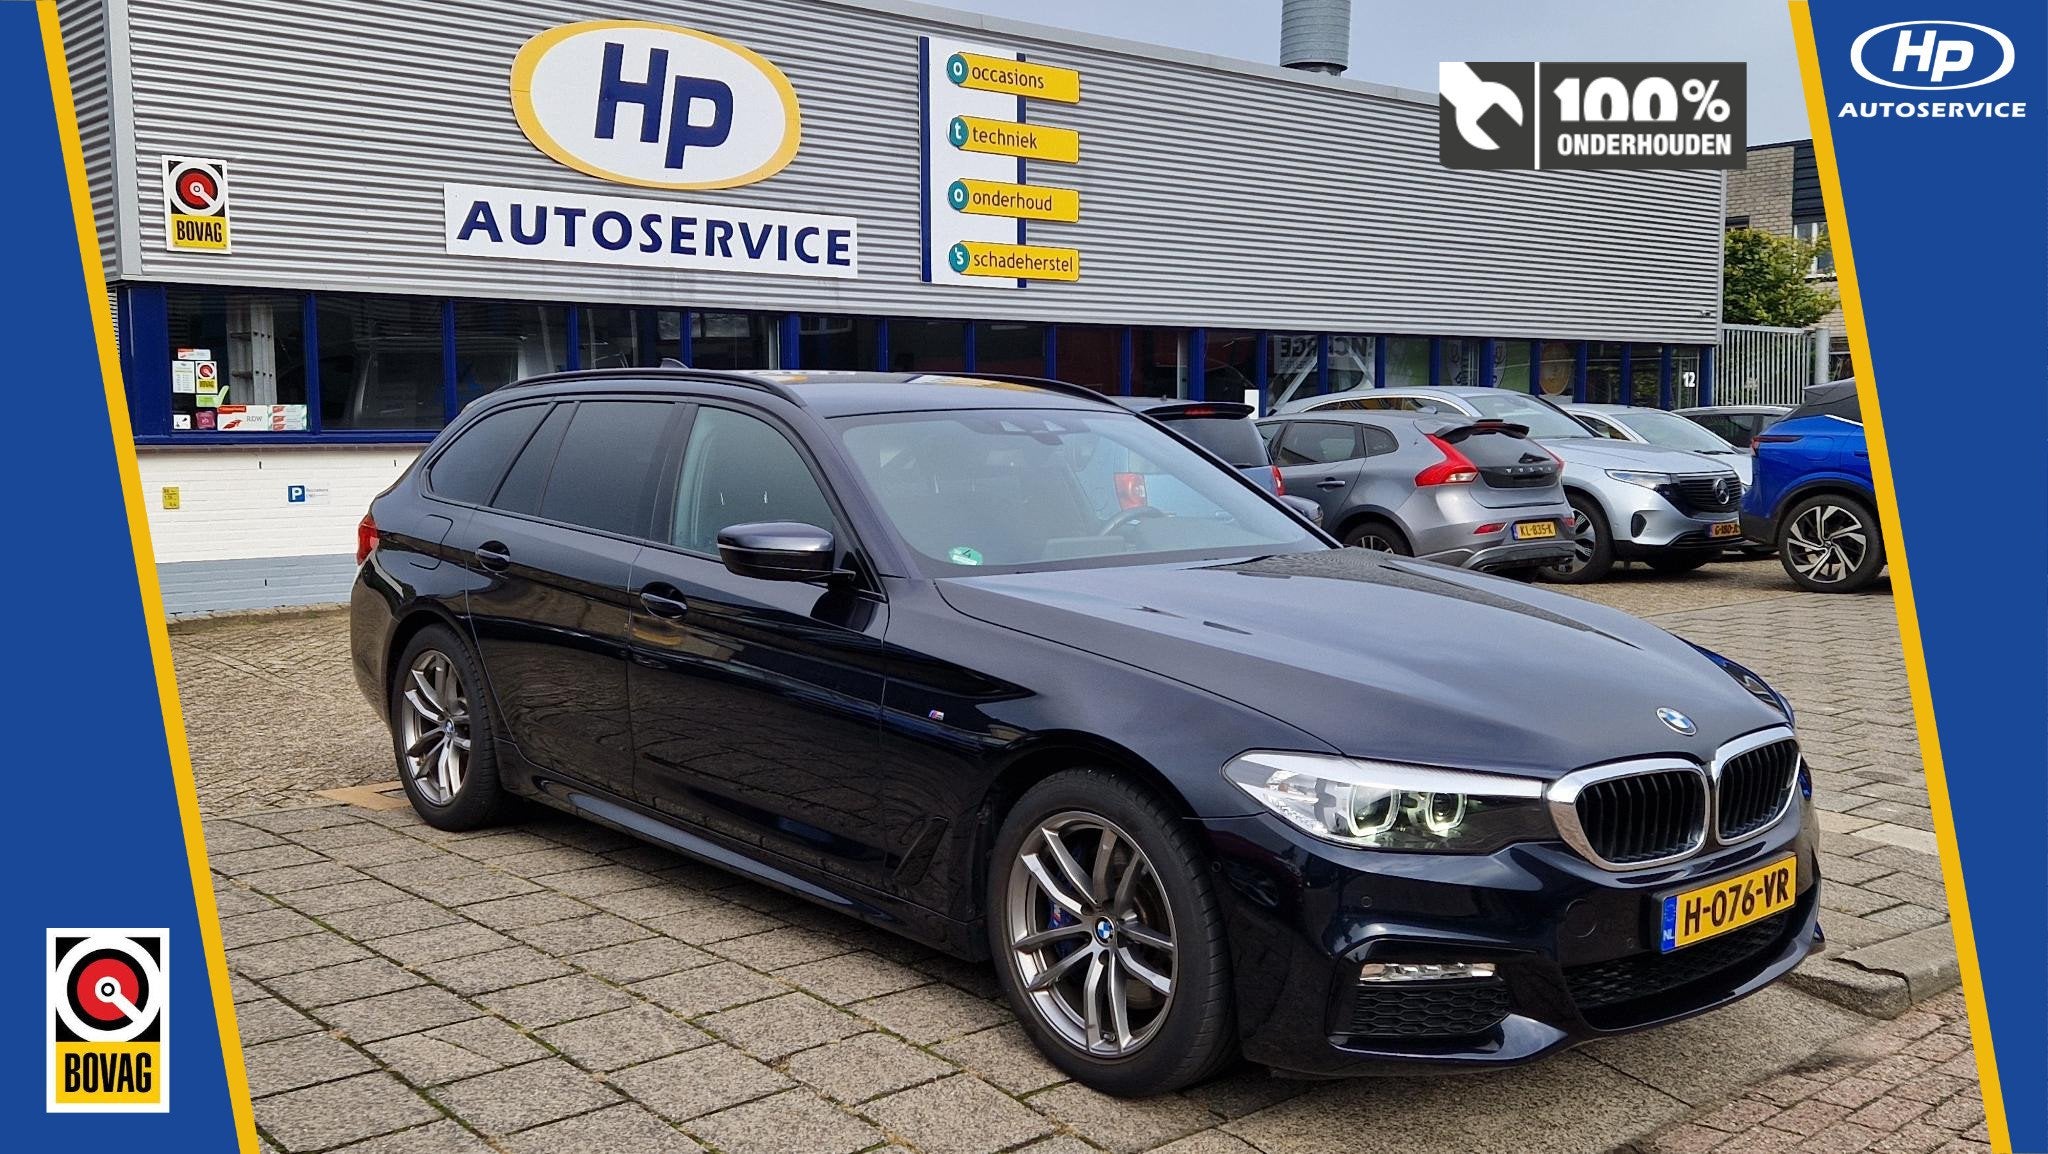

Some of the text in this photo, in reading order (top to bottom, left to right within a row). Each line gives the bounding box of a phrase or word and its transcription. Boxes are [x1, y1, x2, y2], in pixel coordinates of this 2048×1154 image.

[971, 66, 1045, 89] occasions
[972, 126, 1038, 150] techniek
[972, 189, 1052, 212] onderhoud
[176, 219, 223, 243] BOVAG
[456, 200, 851, 267] AUTOSERVICE
[973, 250, 1073, 273] schadeherstel
[1683, 371, 1696, 388] 12
[1519, 523, 1554, 537] KL-835-K
[1662, 866, 1790, 942] NL H-076-VR
